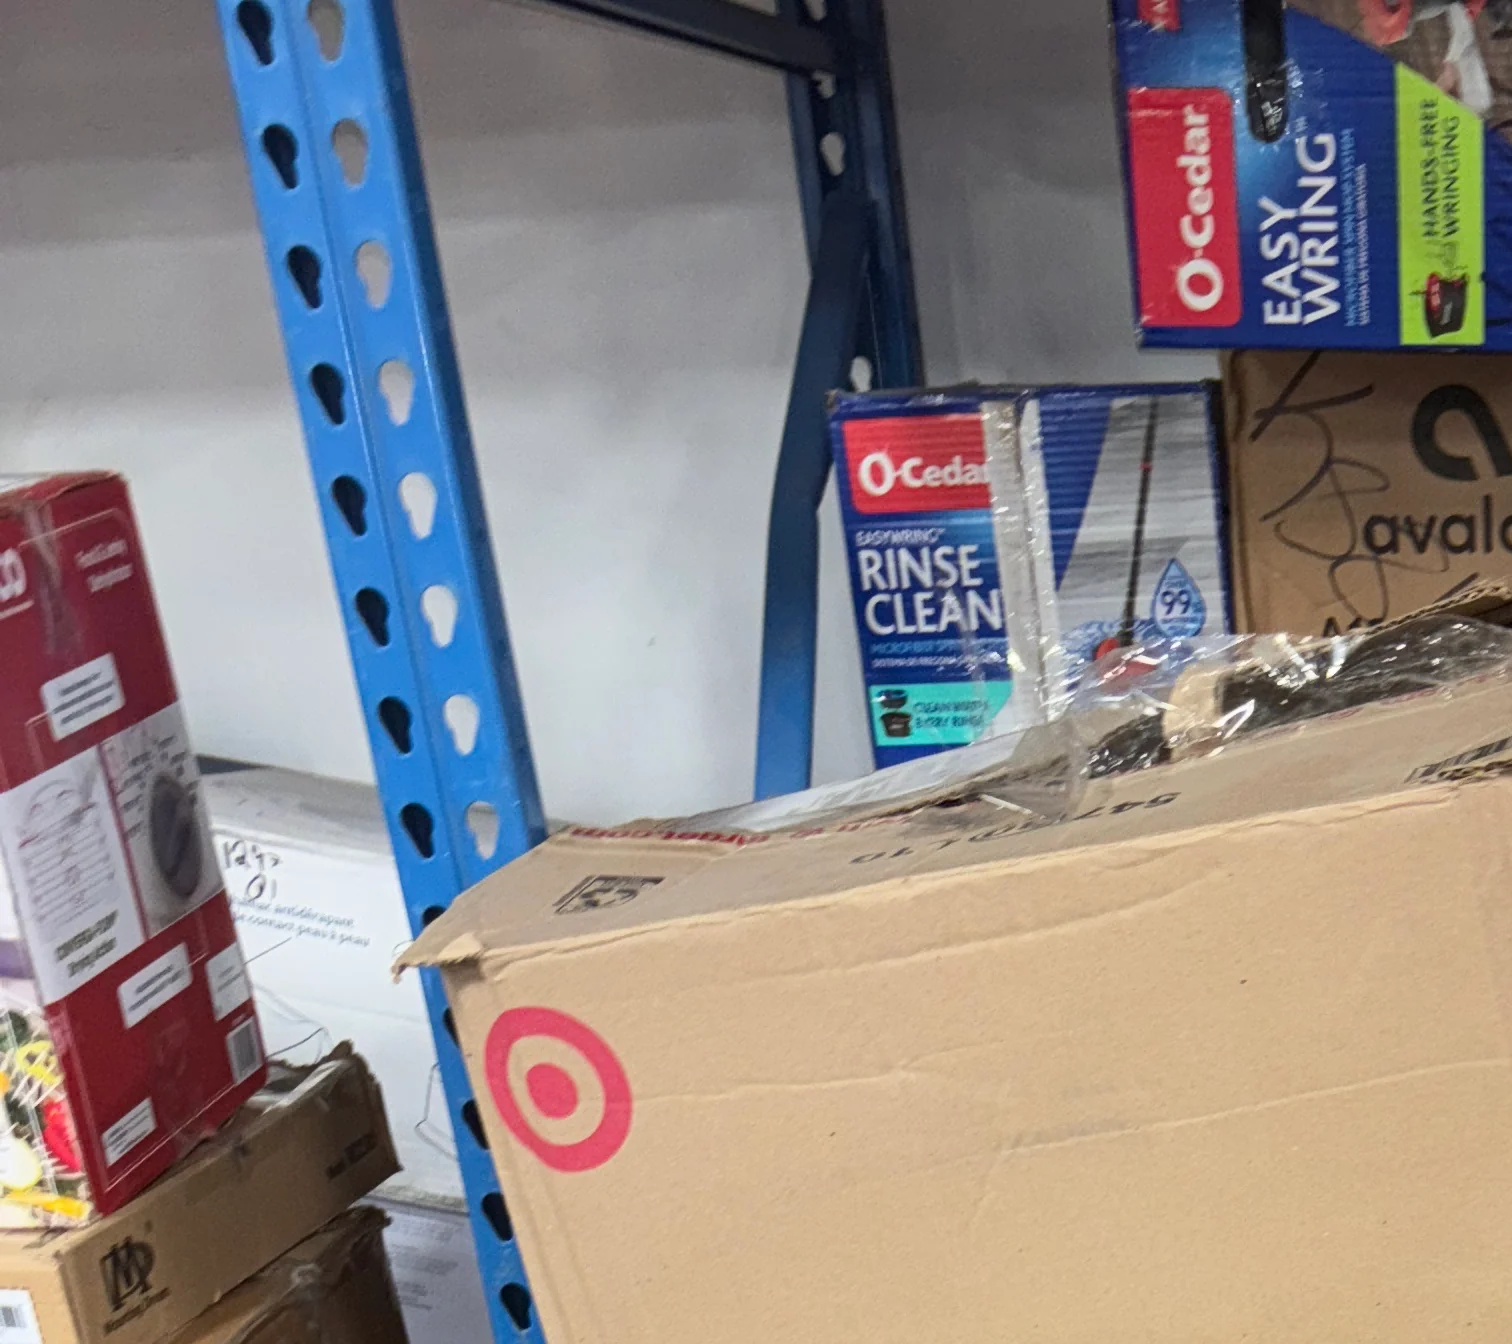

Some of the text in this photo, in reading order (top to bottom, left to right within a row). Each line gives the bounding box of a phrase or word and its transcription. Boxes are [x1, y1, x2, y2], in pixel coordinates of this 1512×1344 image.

[1298, 132, 1340, 326] WRING
[1418, 98, 1439, 238] HANDS-FREE
[1440, 115, 1461, 238] WRINGING
[1260, 196, 1302, 325] EASY
[857, 544, 984, 590] RINSE
[864, 588, 1004, 635] CLEAN
[1160, 588, 1195, 614] 99
